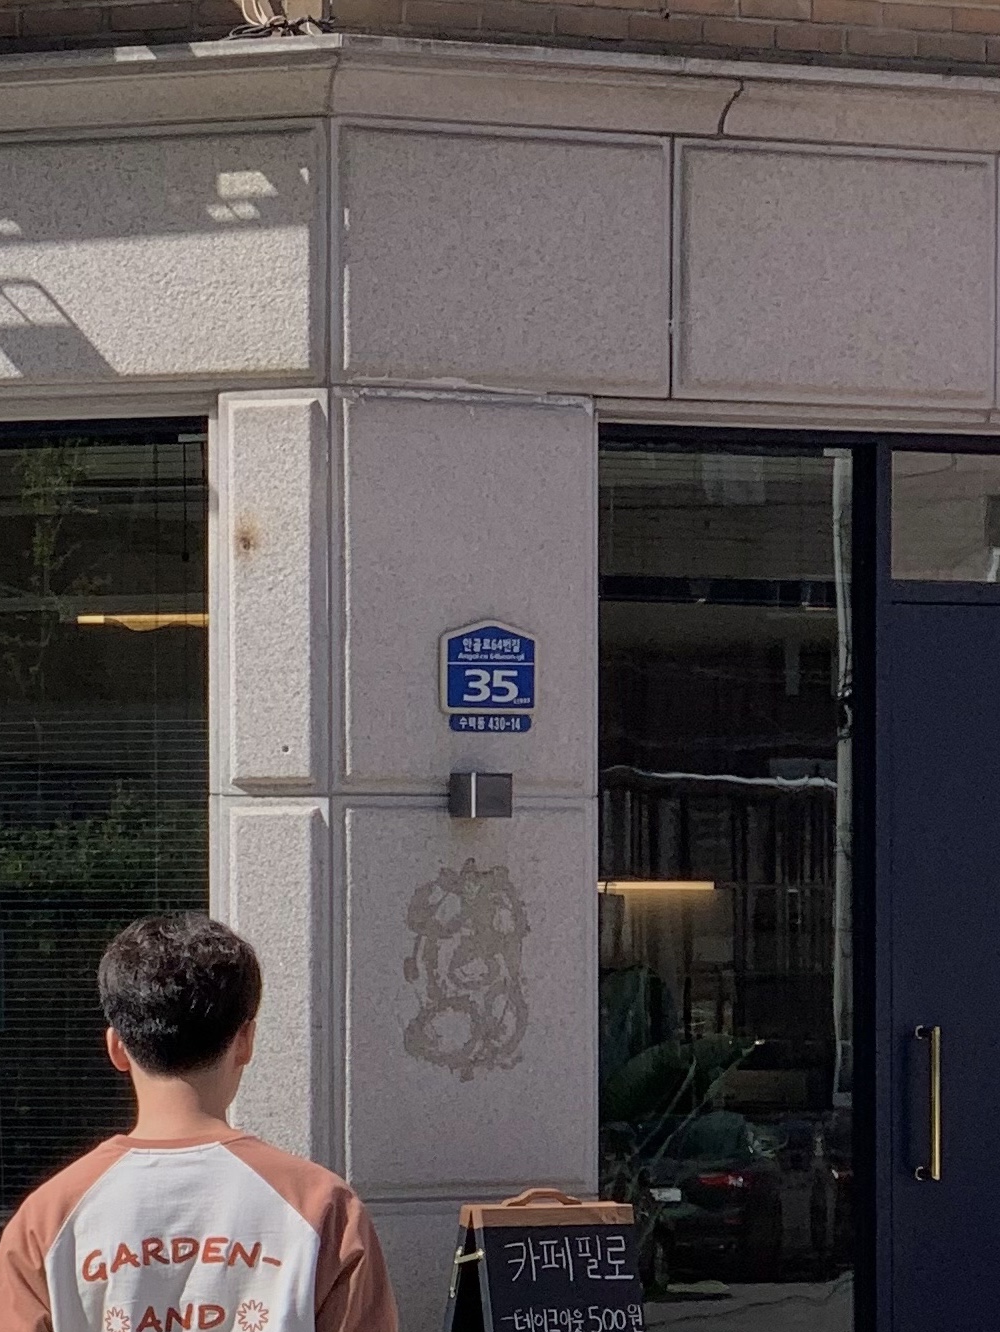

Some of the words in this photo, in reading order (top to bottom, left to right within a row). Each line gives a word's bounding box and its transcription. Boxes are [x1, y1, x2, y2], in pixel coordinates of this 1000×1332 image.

[463, 669, 519, 703] 35
[488, 716, 521, 731] 430-14
[504, 1235, 634, 1281] 카페필로
